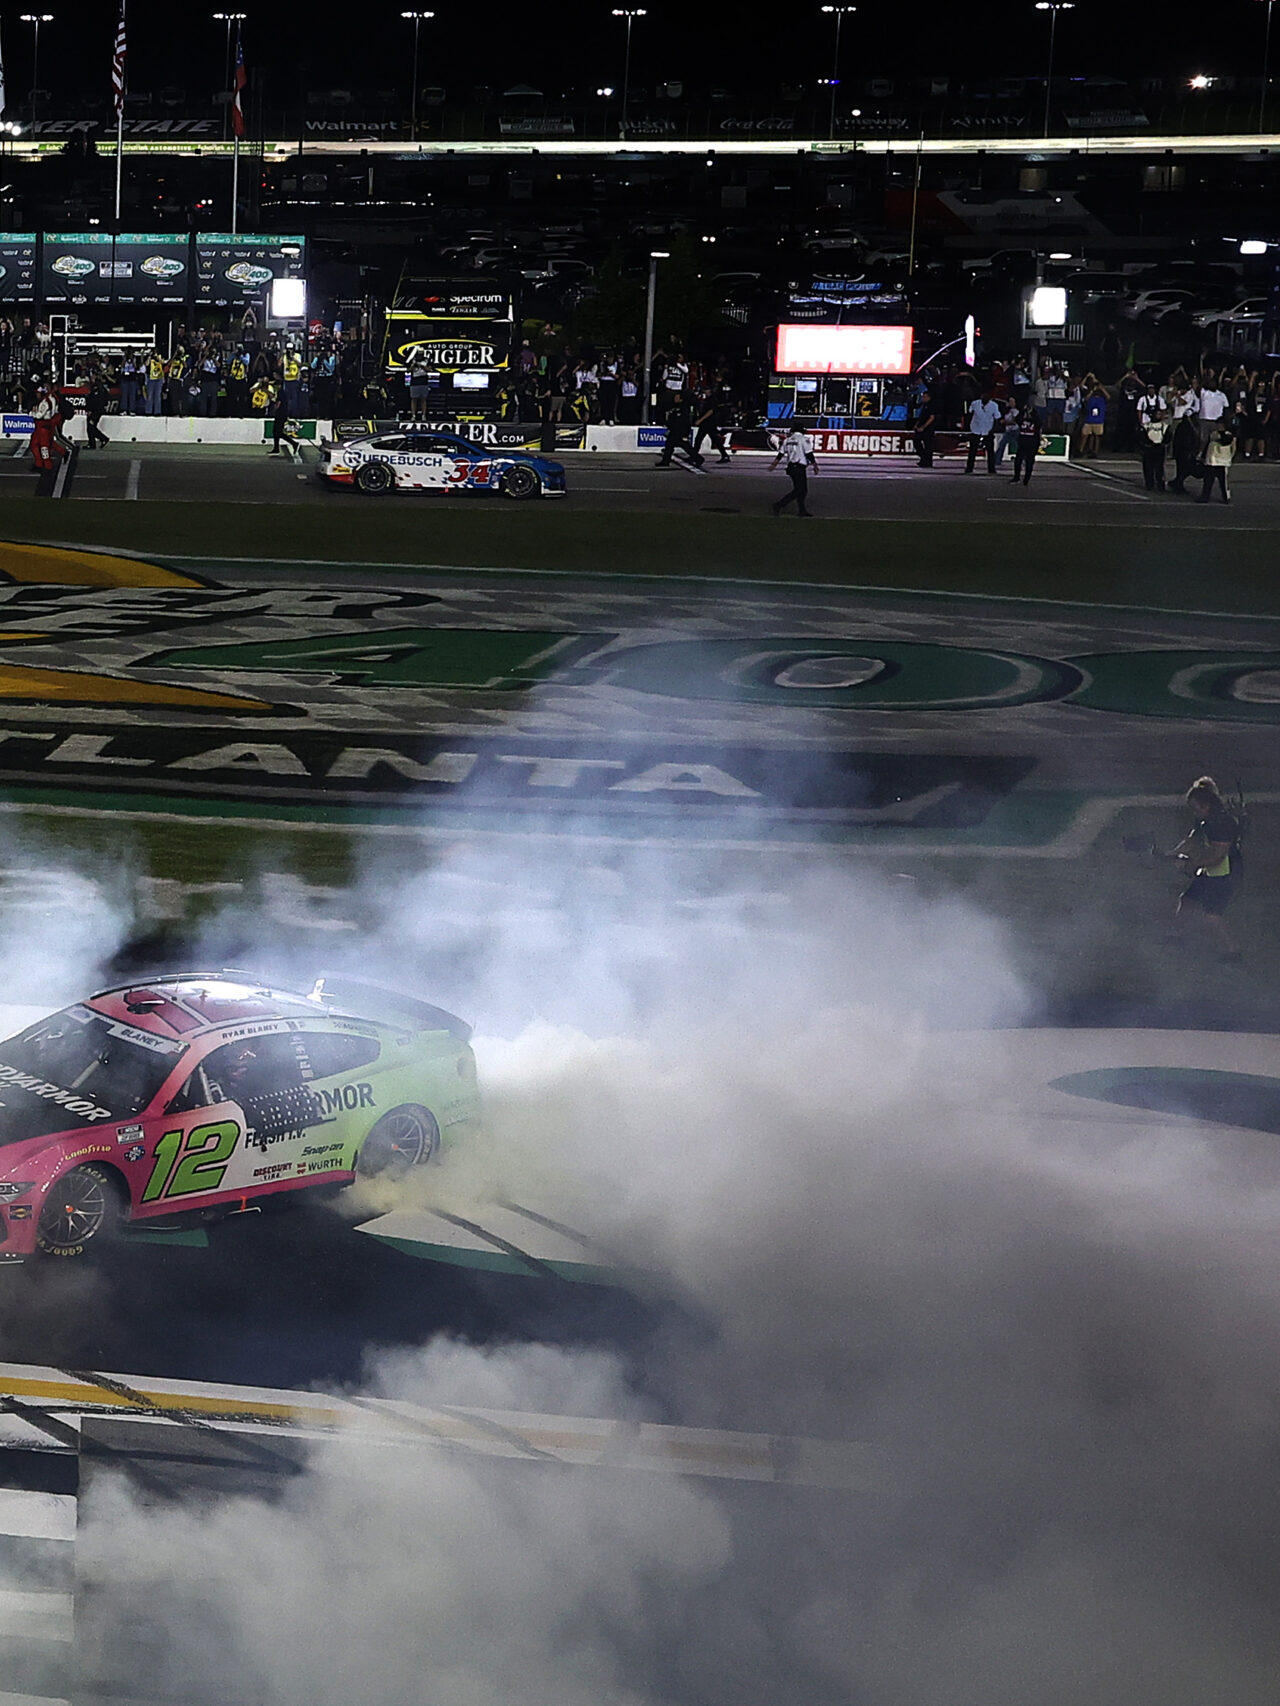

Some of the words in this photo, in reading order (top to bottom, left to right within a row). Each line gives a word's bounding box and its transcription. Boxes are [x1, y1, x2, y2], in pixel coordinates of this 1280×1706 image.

[104, 119, 221, 134] STATE
[305, 120, 398, 132] Walmart
[450, 294, 502, 305] Spectrum
[405, 345, 495, 365] ZEIGLER
[4, 419, 36, 429] Walma
[639, 433, 667, 442] Walm
[826, 434, 838, 450] A
[842, 434, 917, 453] MOOSE.O
[447, 457, 492, 483] 34
[120, 1028, 164, 1047] BLANEY
[222, 1029, 246, 1039] RYAN
[247, 1023, 279, 1034] BLANEY
[64, 1144, 112, 1162] GOODYEAR
[140, 1119, 242, 1204] 12
[253, 1162, 293, 1177] DISCOUNT
[79, 1165, 108, 1184] EAGLE
[264, 1172, 281, 1181] TIRE
